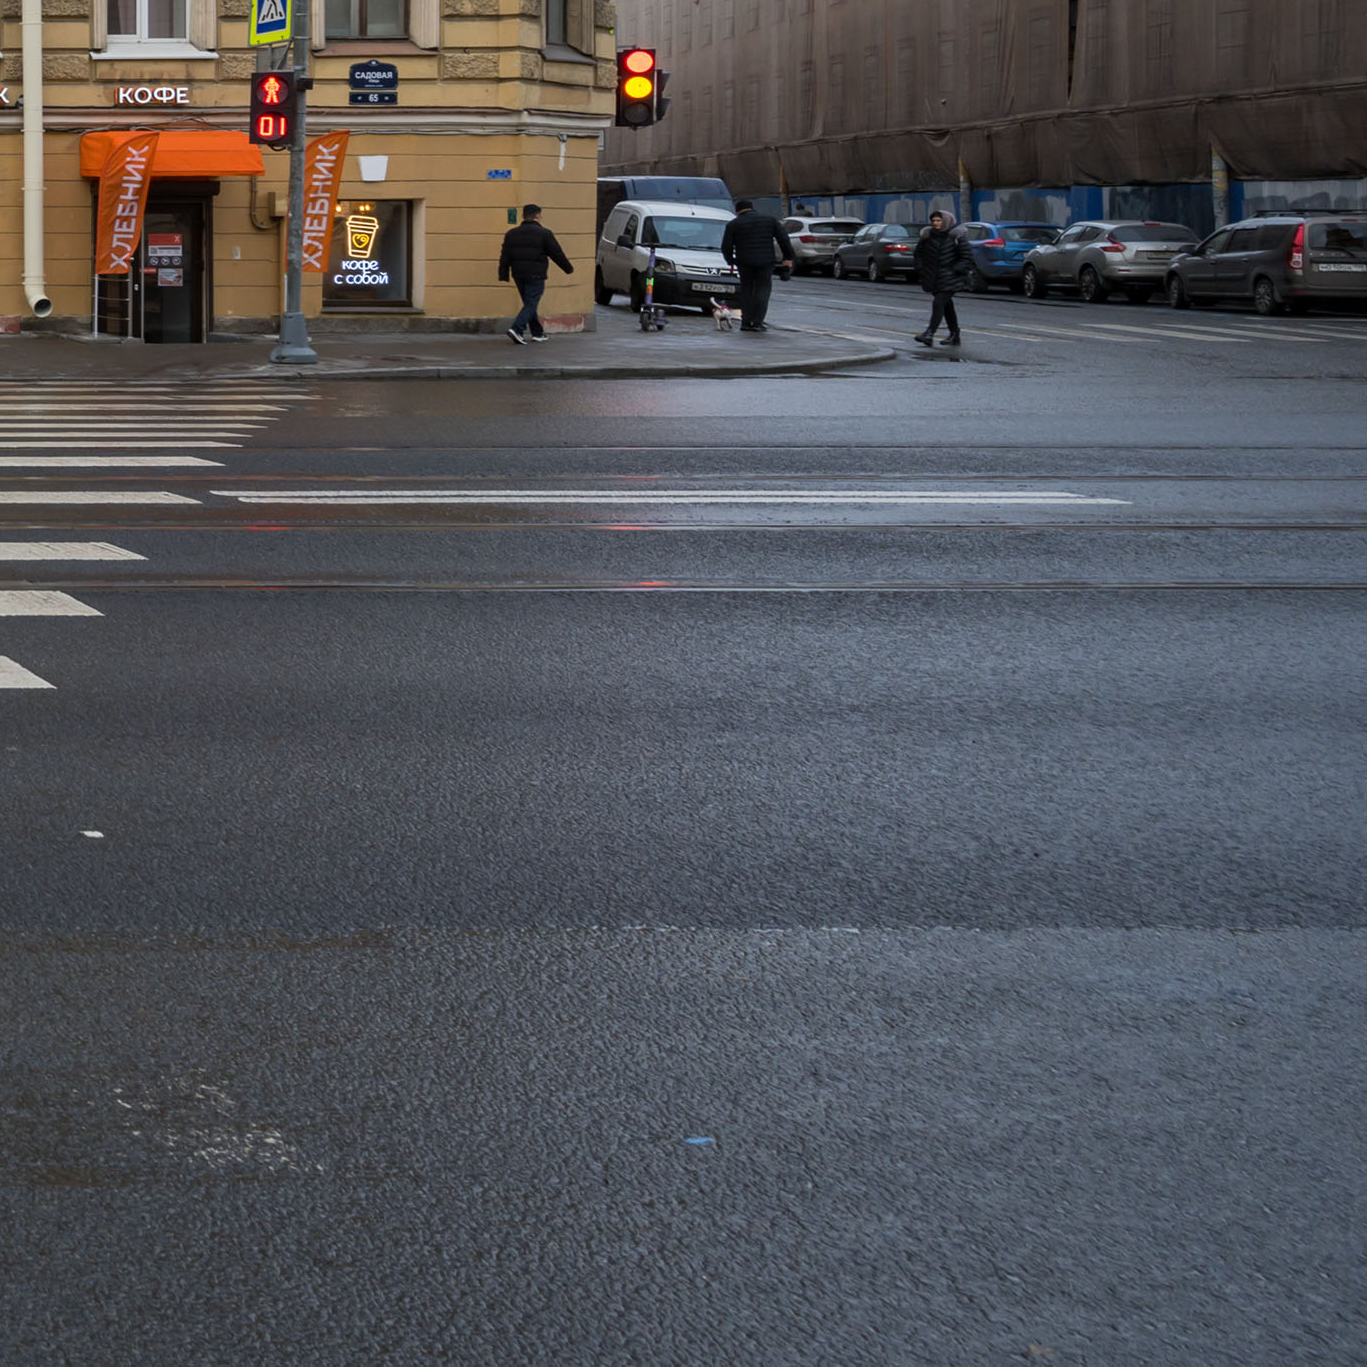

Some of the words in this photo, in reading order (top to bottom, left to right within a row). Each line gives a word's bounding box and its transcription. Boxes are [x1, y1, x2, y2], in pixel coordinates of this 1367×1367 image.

[355, 71, 393, 79] САДОВАЯ
[118, 87, 190, 104] КОФЕ
[369, 93, 379, 102] 65
[109, 145, 150, 269] ХЛЕБНИК
[301, 142, 340, 269] ХЛЕБНИК
